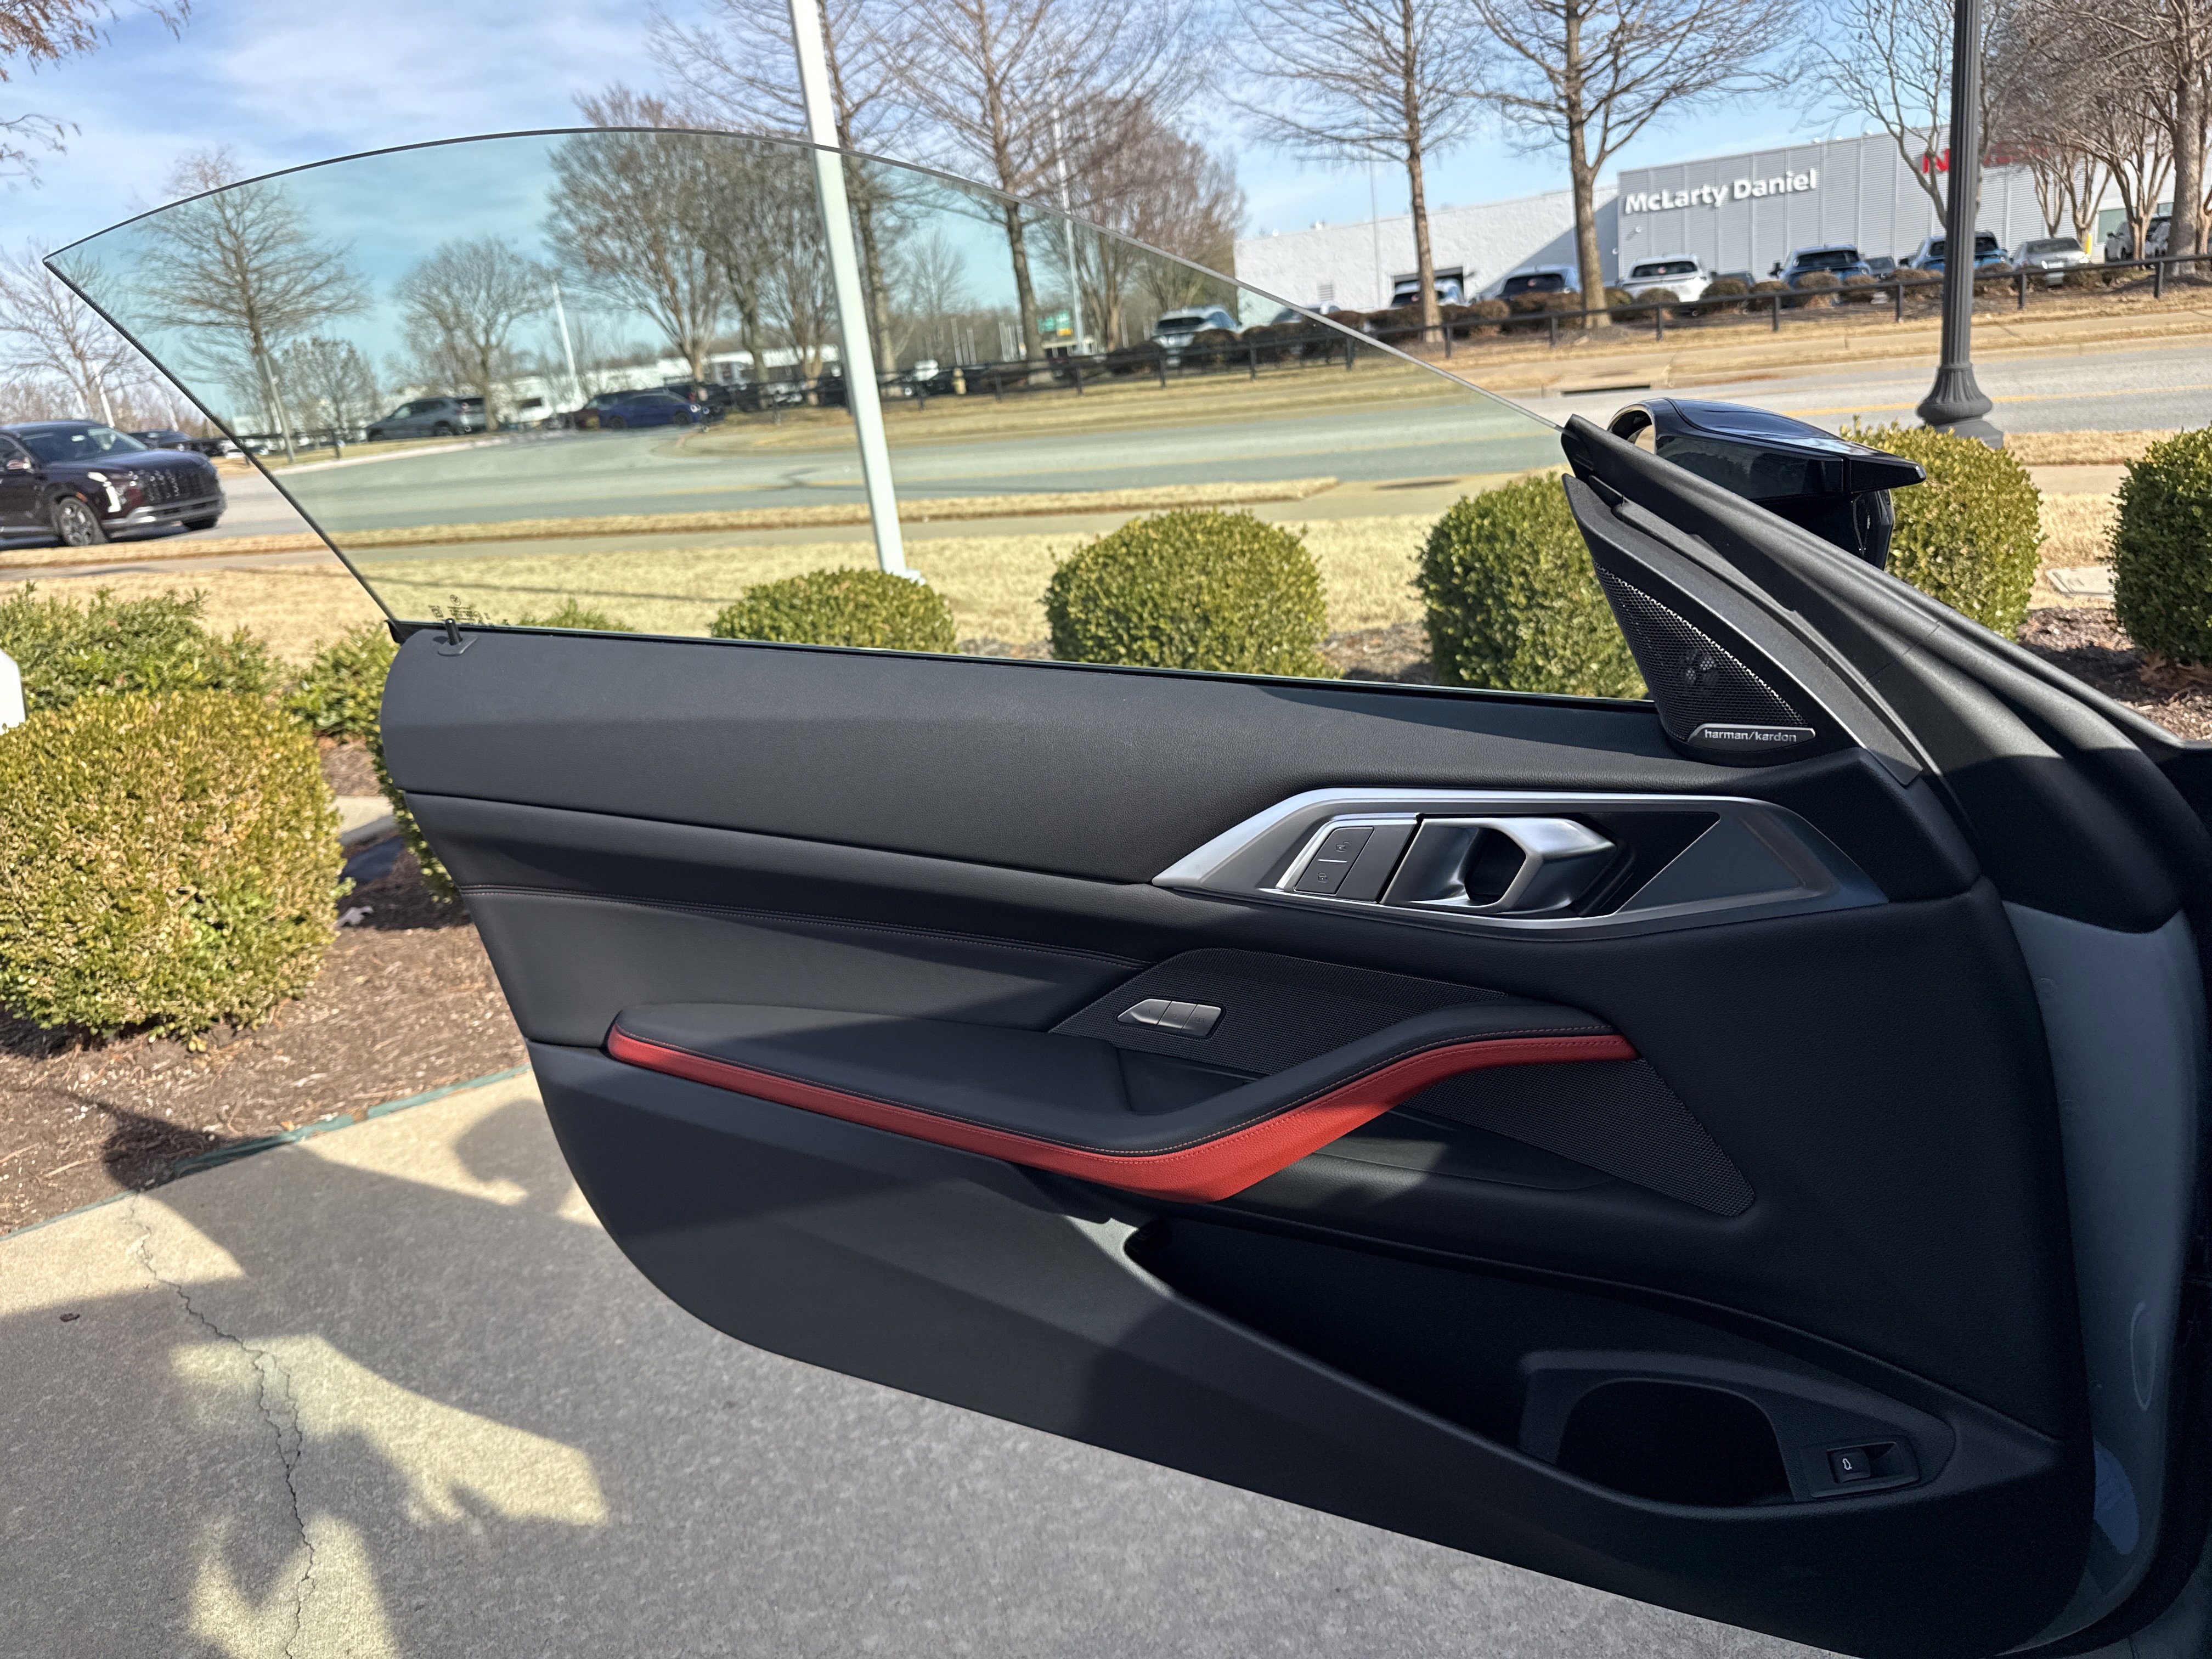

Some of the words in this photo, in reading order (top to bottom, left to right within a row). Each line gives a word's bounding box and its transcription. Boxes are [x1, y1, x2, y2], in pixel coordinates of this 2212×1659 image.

[1625, 184, 1729, 215] McLarty
[1733, 168, 1818, 200] Daniel
[1705, 729, 1797, 742] harman/kardon
